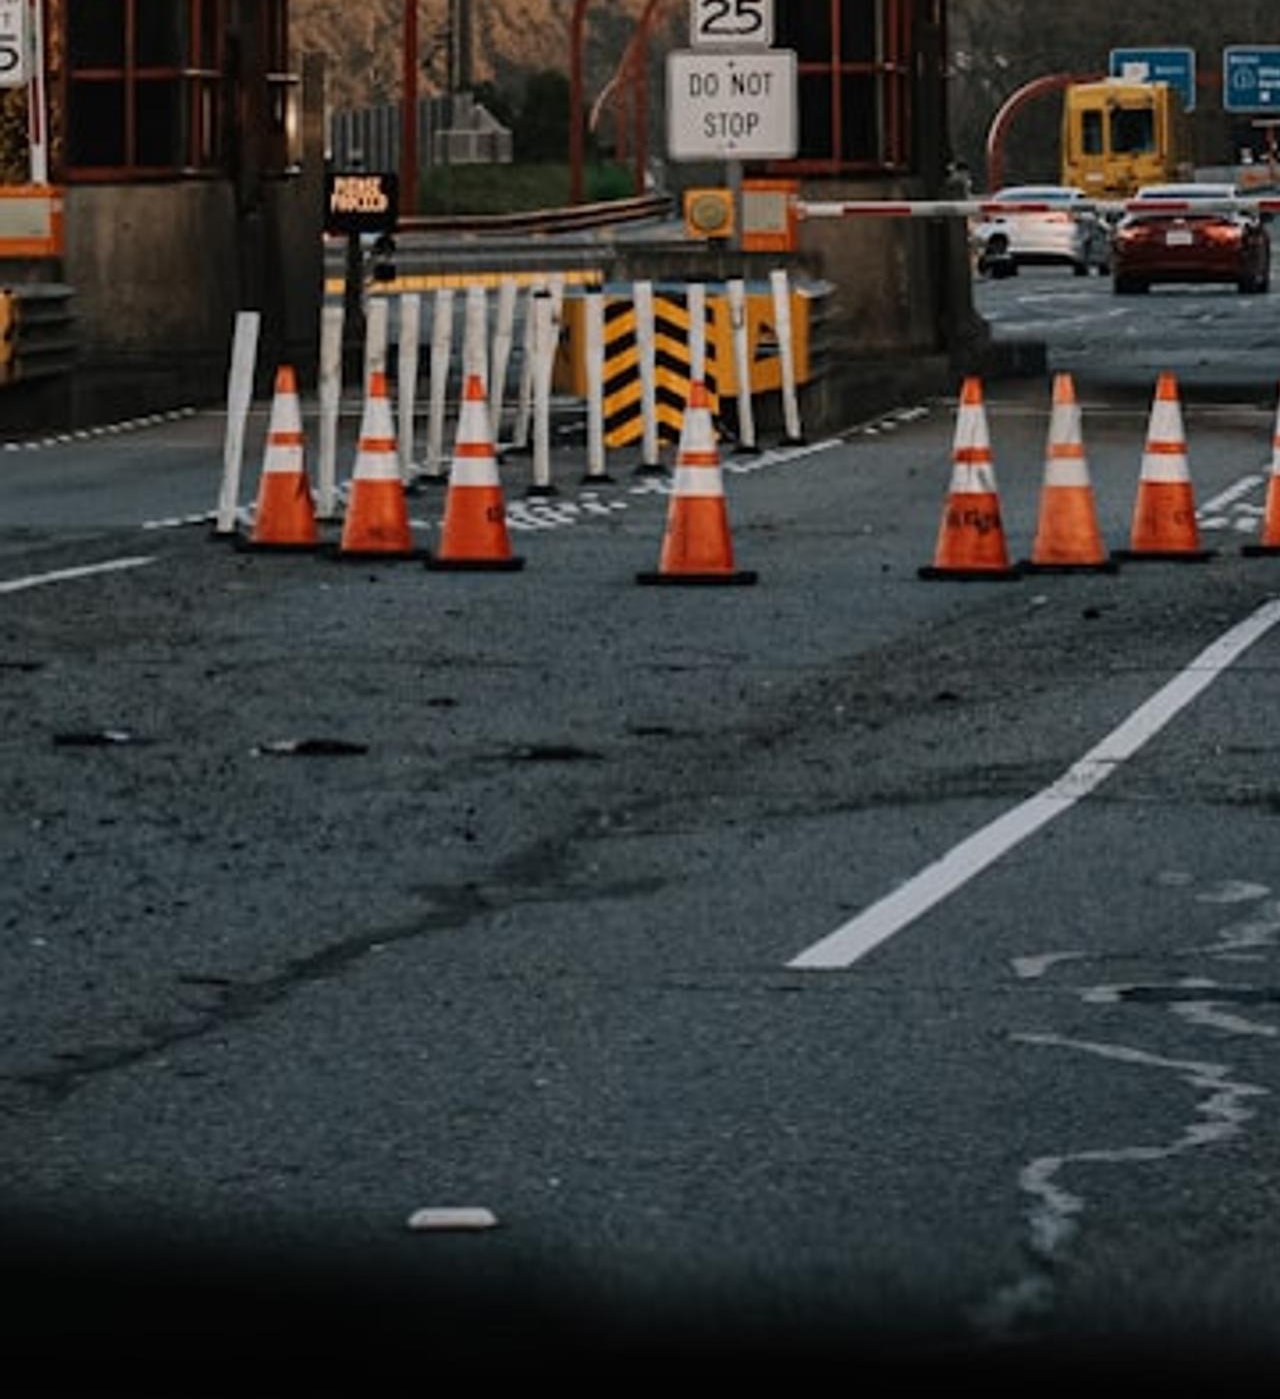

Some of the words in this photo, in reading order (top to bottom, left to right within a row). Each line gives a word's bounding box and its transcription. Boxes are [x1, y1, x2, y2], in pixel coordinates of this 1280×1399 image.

[689, 72, 720, 97] DO
[731, 71, 773, 97] NOT
[703, 112, 759, 139] STOP
